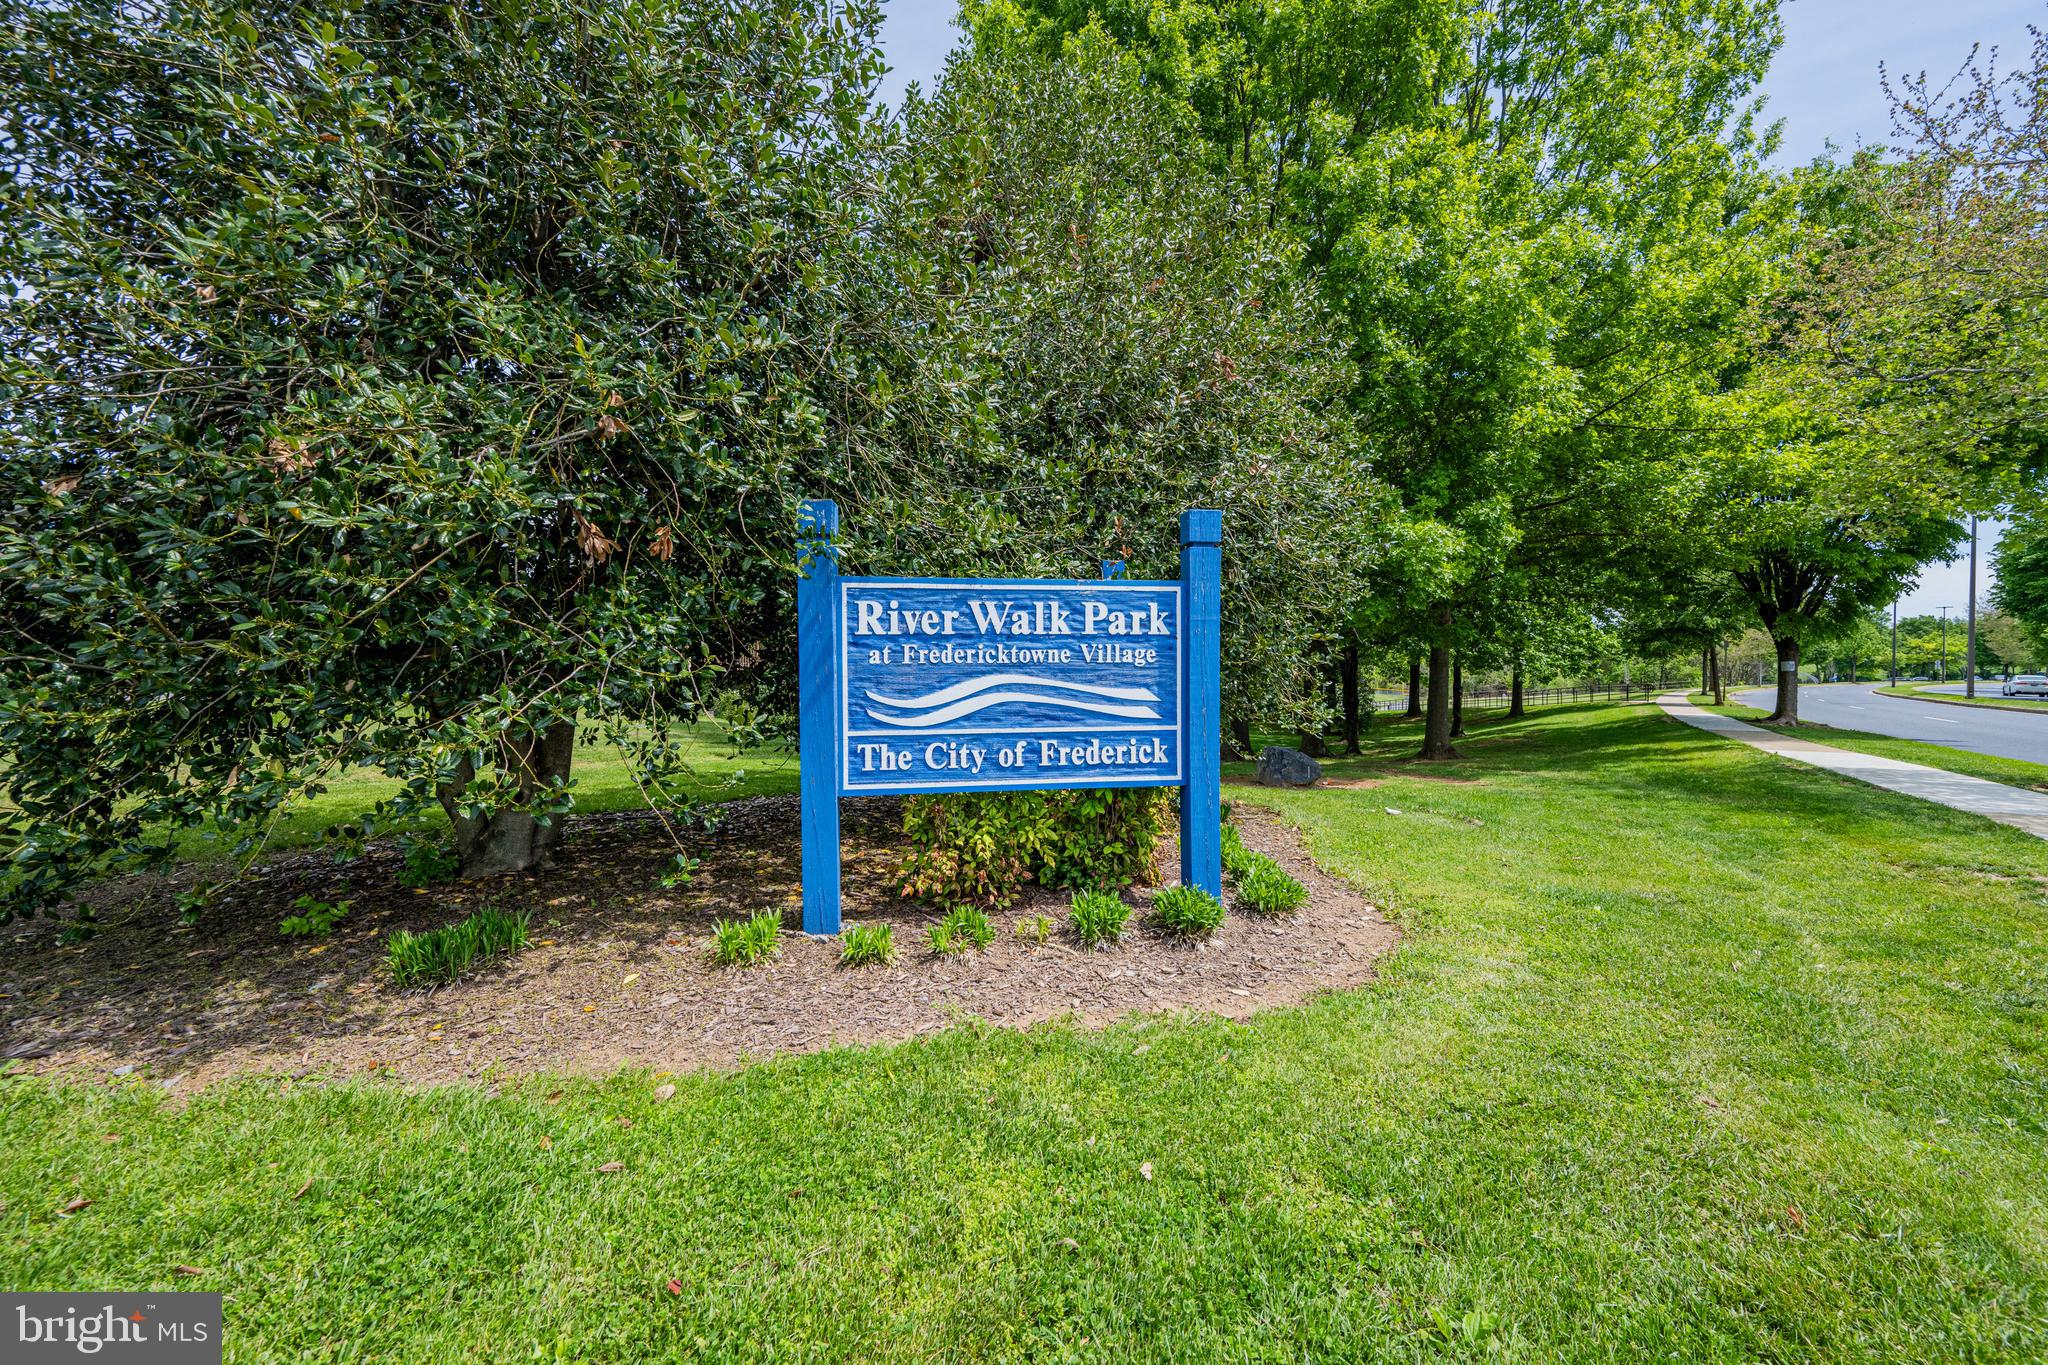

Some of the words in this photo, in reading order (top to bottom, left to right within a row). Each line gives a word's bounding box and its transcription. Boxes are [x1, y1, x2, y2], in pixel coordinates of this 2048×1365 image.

[854, 600, 959, 635] River
[968, 601, 1071, 635] Walk
[1081, 601, 1170, 635] Park
[868, 646, 891, 664] at
[902, 644, 1071, 665] Fredericktowne
[1080, 644, 1157, 667] Village
[857, 743, 912, 771] The
[924, 742, 986, 773] City
[998, 741, 1027, 767] of
[1039, 738, 1169, 766] Frederick
